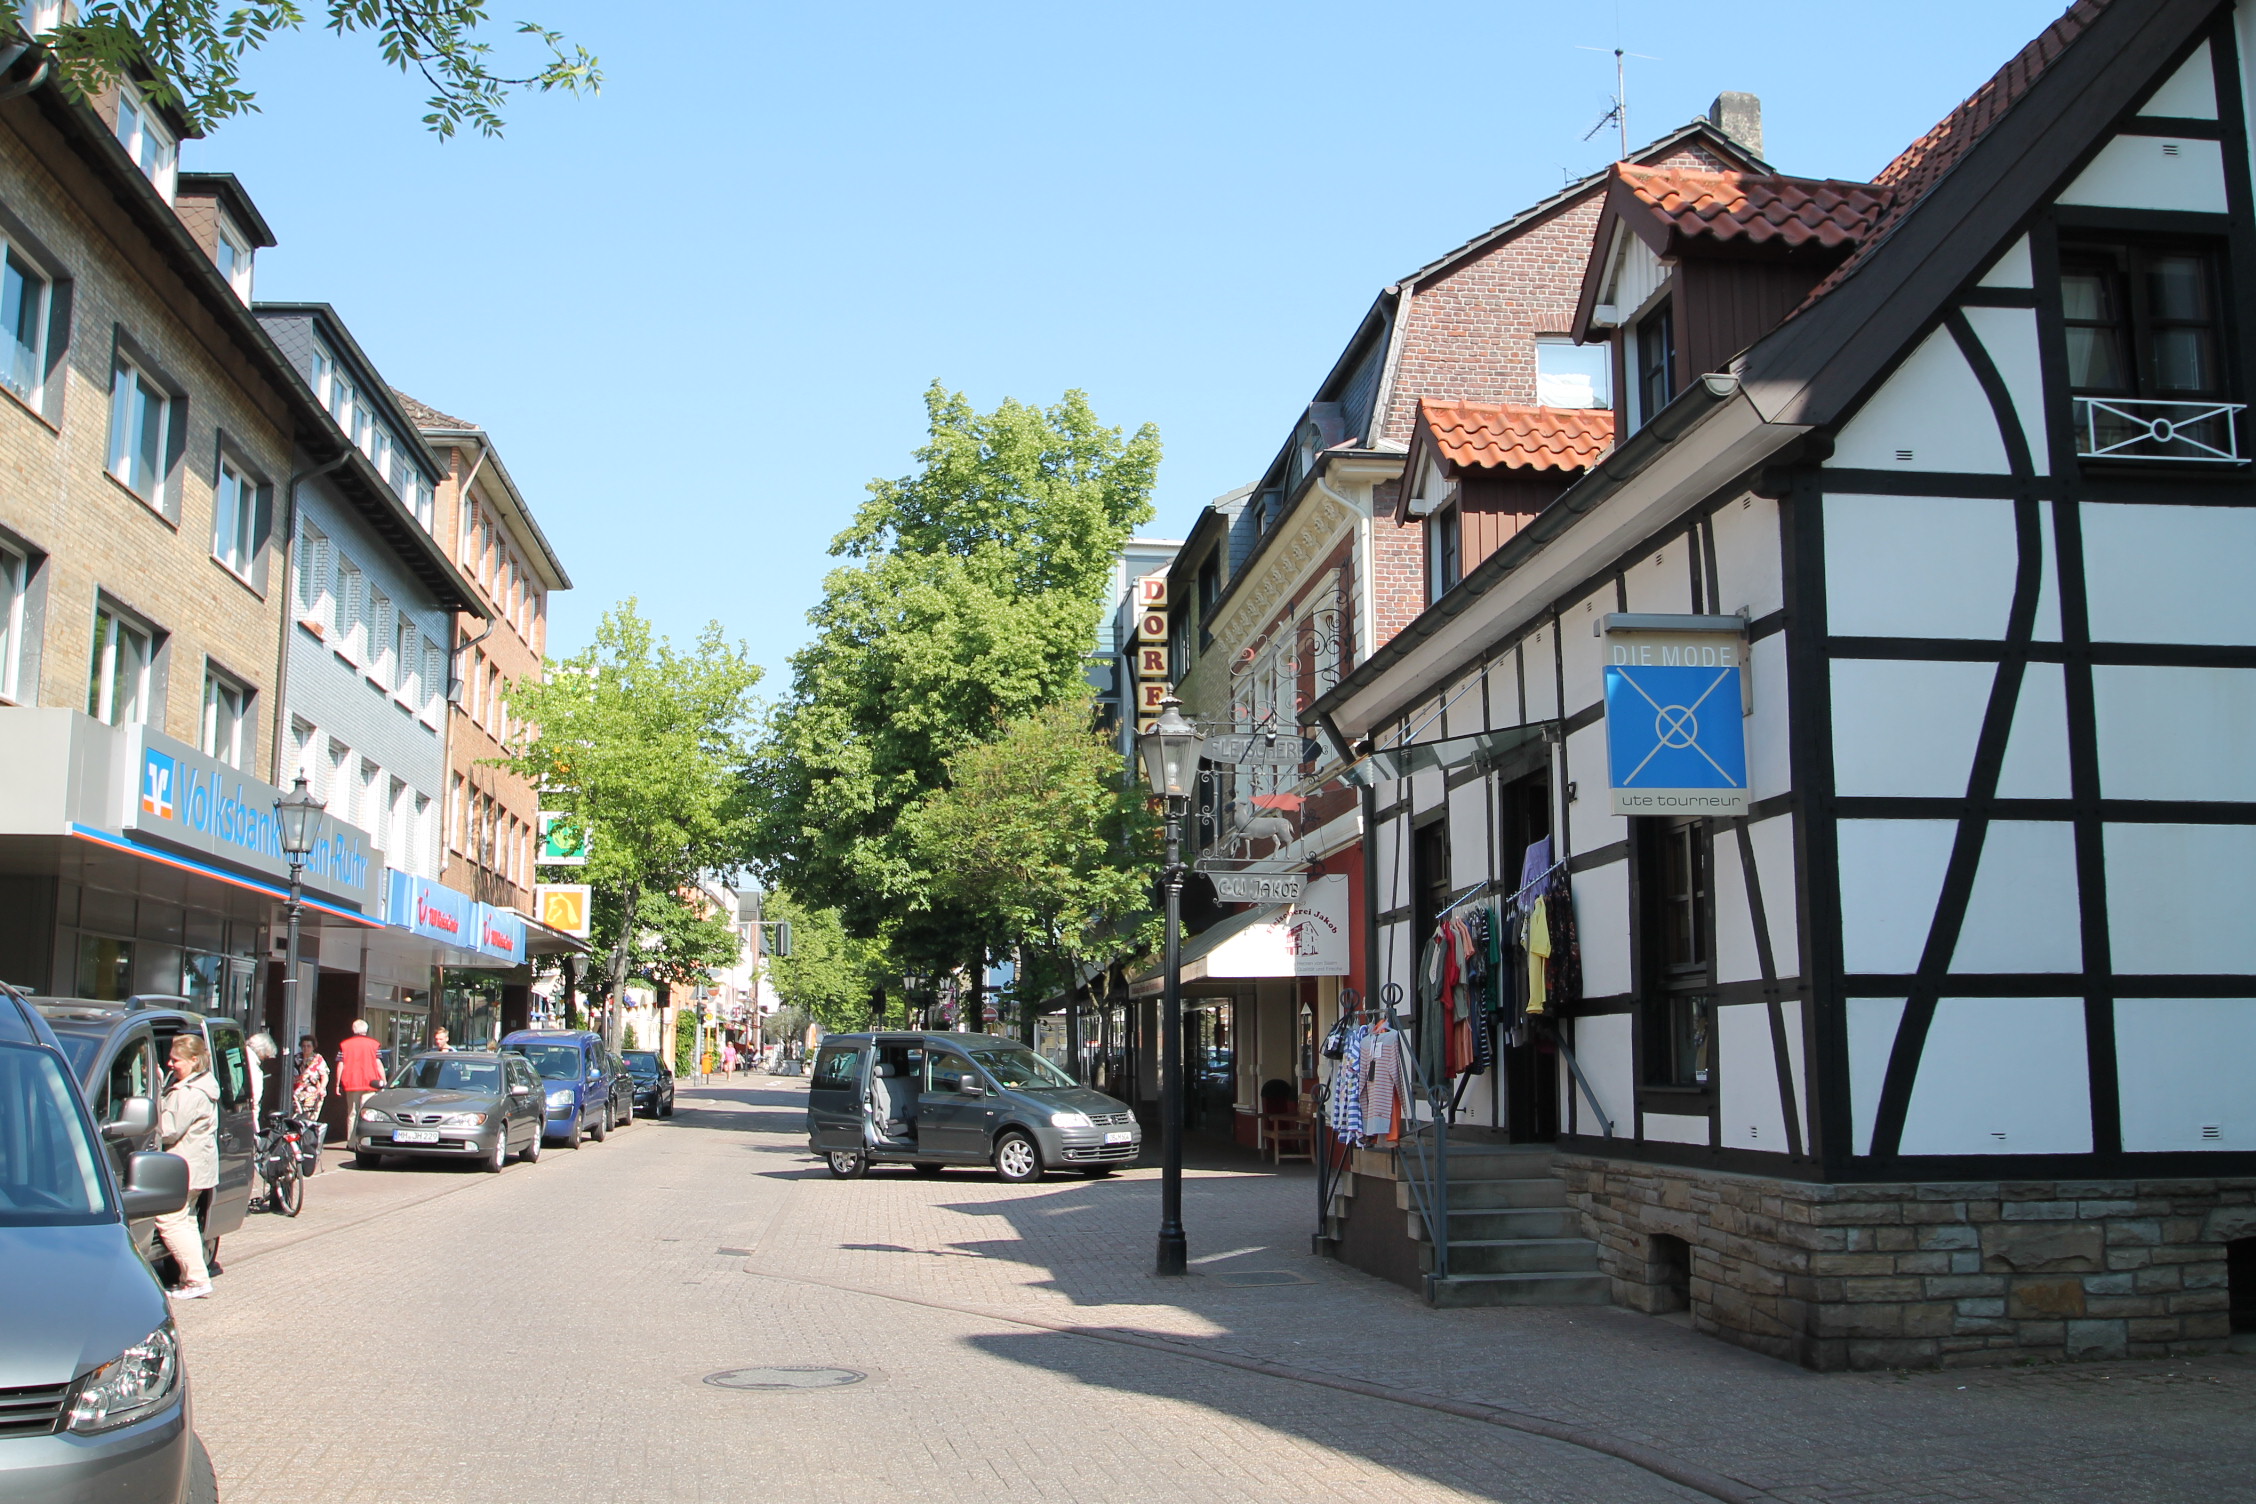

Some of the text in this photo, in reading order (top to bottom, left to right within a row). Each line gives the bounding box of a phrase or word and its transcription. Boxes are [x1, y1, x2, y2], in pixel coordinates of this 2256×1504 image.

[1613, 645, 1732, 668] DIE MODE
[180, 762, 282, 859] Volksbank
[1622, 795, 1741, 807] ute tourneur
[1250, 879, 1299, 901] JAKOB
[1266, 908, 1338, 935] Fleischerei Jakob
[423, 1132, 438, 1140] 229
